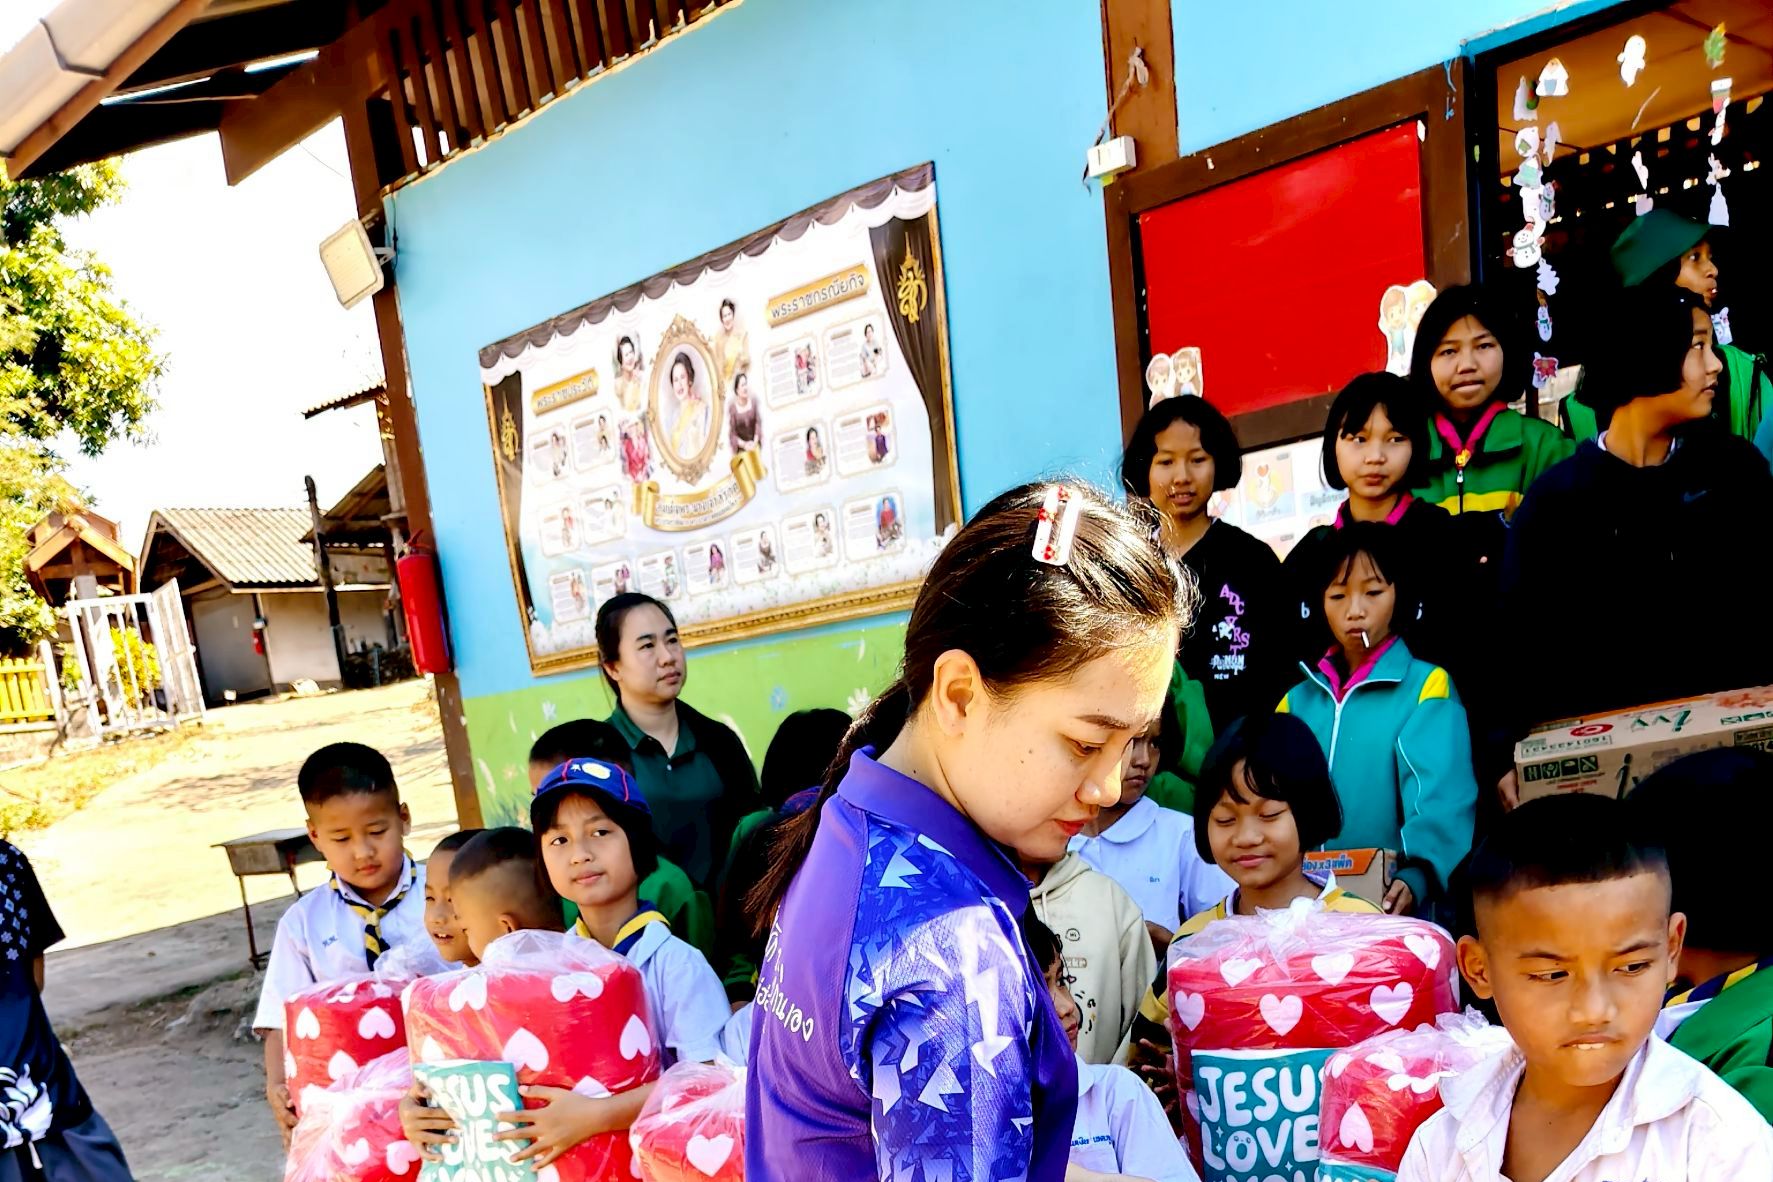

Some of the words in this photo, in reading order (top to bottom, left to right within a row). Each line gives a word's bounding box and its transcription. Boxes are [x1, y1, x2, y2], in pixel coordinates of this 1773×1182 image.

[771, 273, 865, 318] พระราชกรณียกิจ
[1199, 1063, 1325, 1127] JESU
[1201, 1114, 1320, 1173] LOVE
